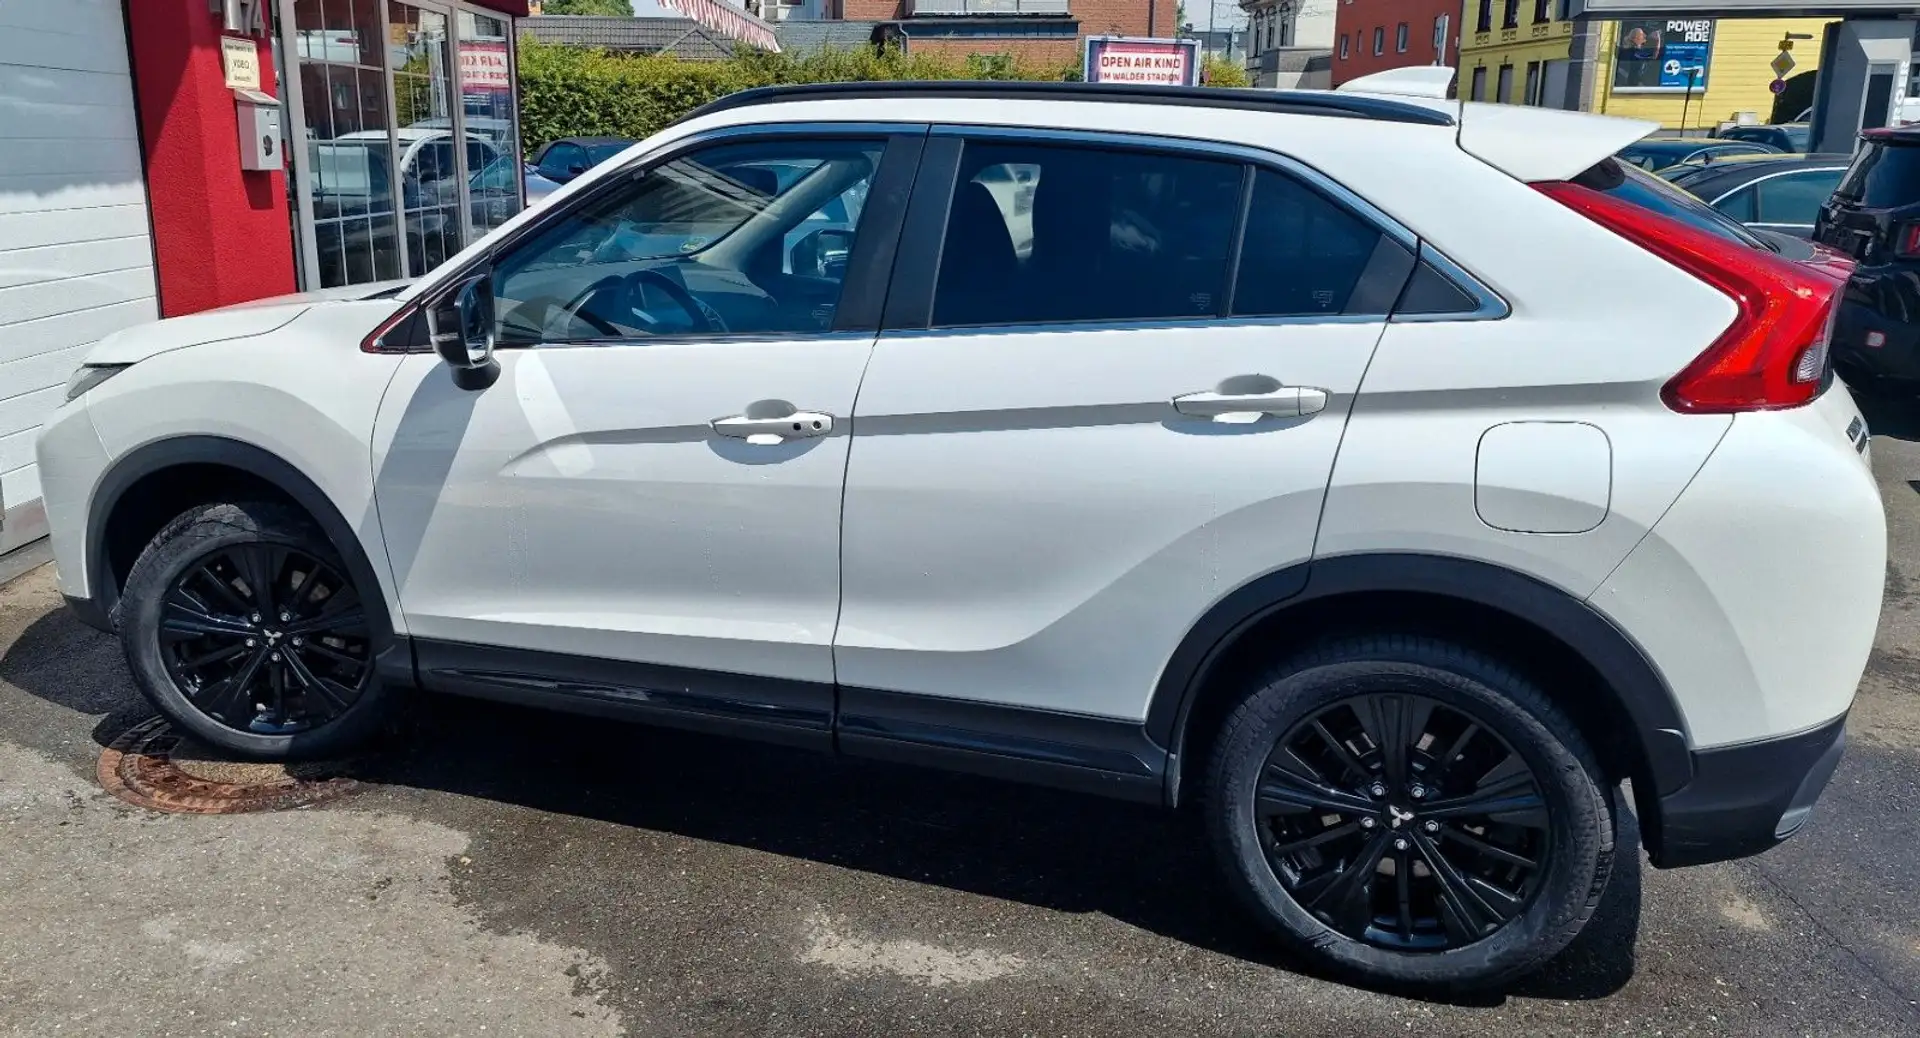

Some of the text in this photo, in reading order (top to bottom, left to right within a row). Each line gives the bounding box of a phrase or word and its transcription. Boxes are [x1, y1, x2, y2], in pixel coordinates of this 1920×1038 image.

[1666, 20, 1710, 32] POWER
[1685, 31, 1709, 42] ADE
[1101, 56, 1131, 67] OPEN
[1134, 58, 1152, 68] AIR
[1113, 72, 1145, 80] WALDER
[1147, 73, 1179, 81] STADION
